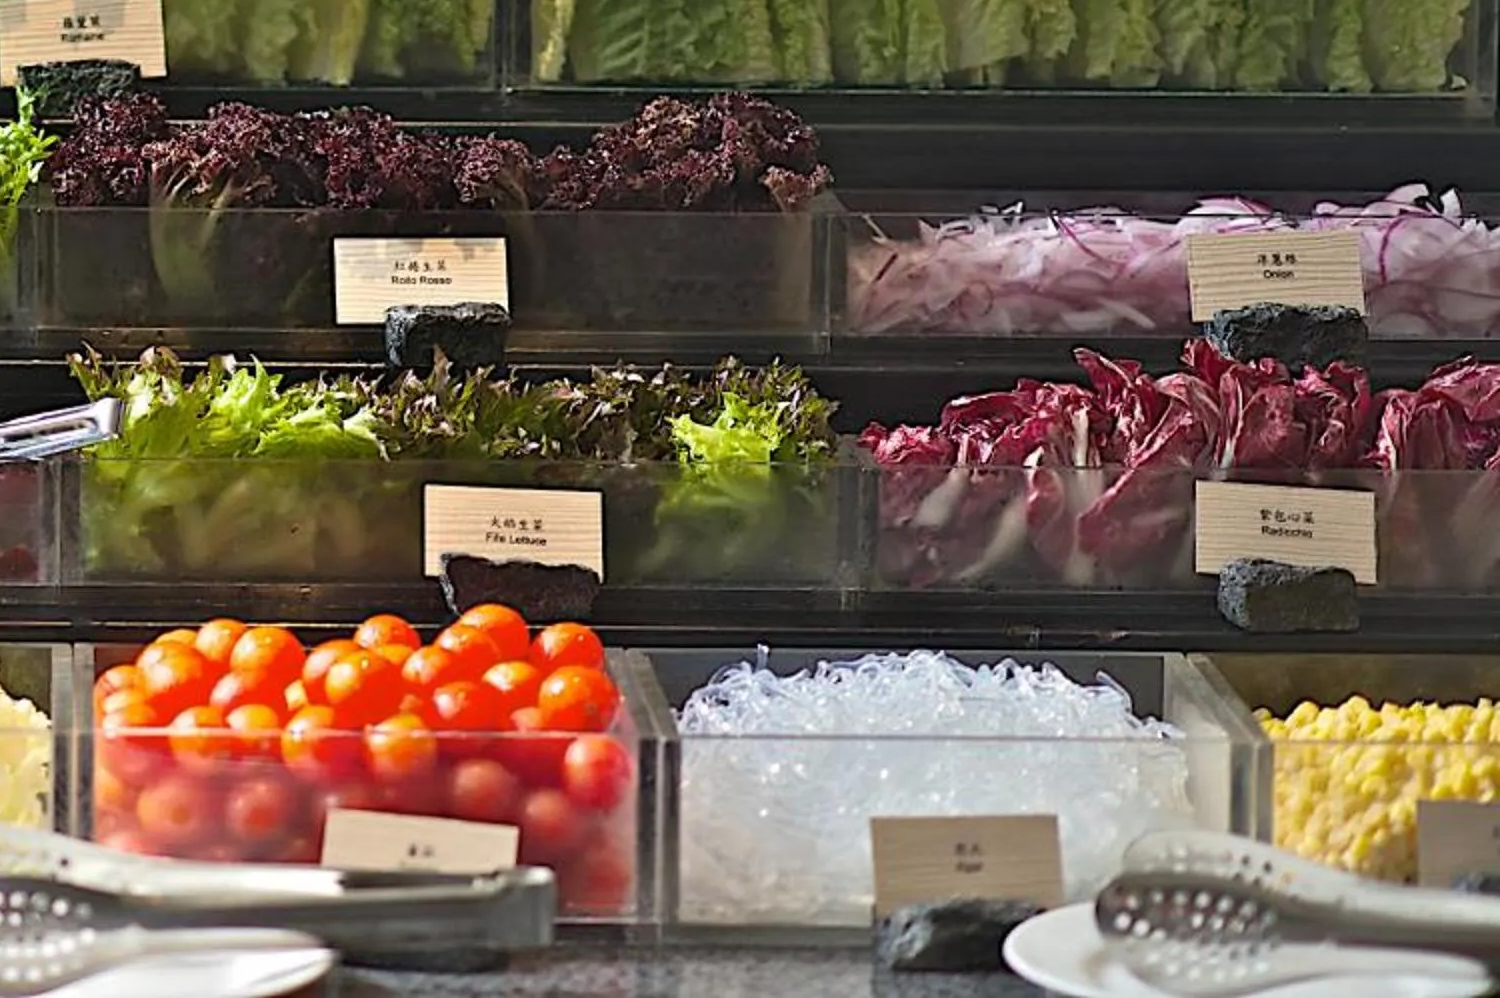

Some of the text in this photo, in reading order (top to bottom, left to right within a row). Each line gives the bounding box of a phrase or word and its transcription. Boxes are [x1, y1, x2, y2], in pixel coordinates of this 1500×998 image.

[1263, 269, 1295, 279] Onion
[419, 276, 453, 286] Rosso
[509, 535, 547, 547] Lettuce
